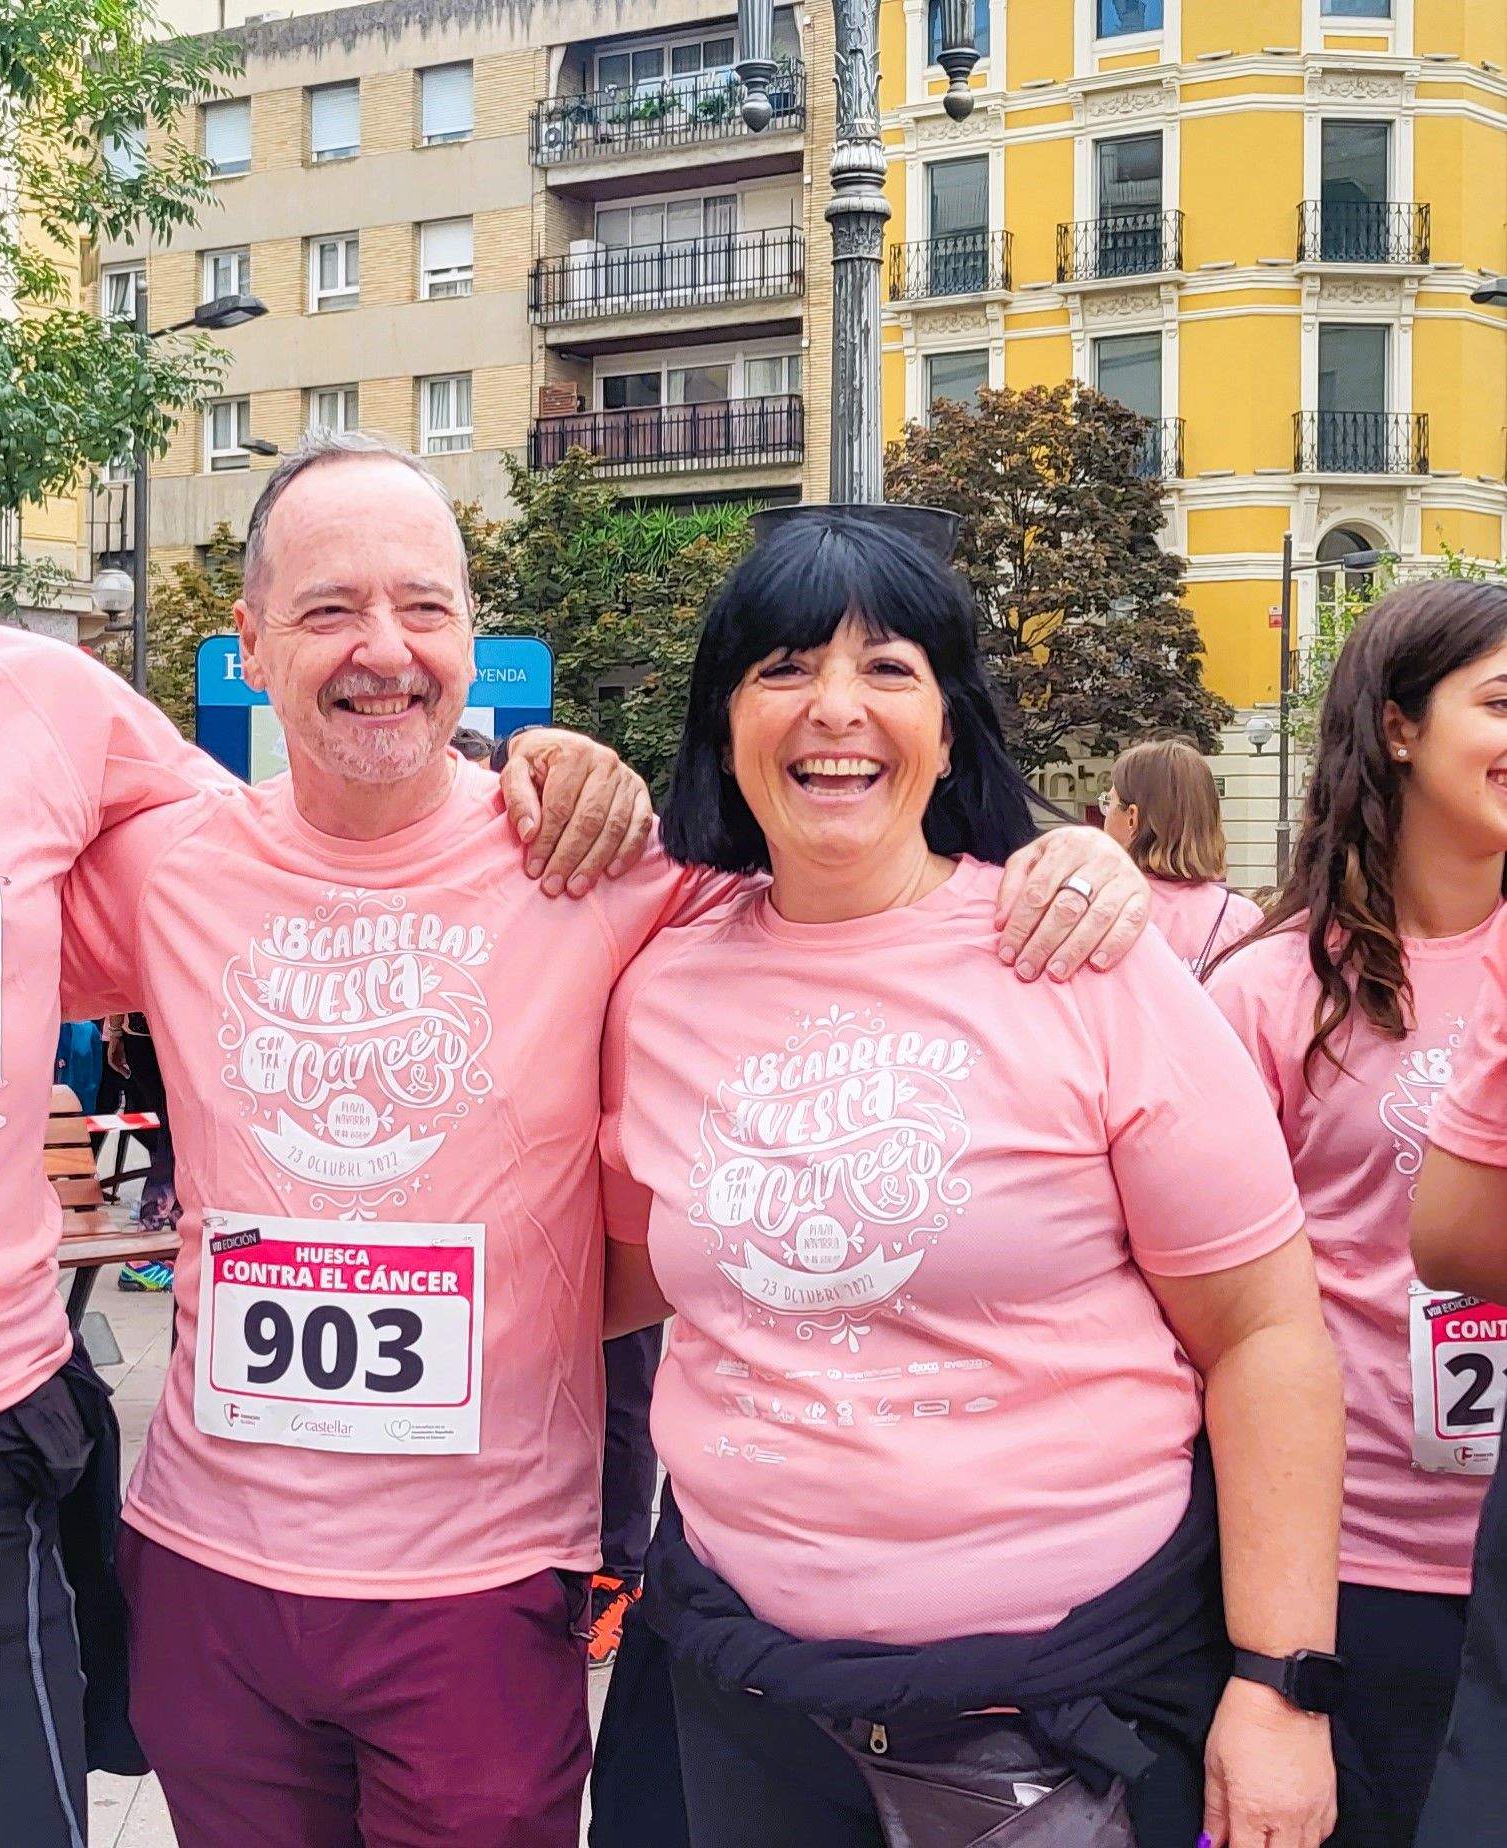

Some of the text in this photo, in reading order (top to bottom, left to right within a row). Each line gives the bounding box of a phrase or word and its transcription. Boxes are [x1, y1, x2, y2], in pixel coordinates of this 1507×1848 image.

[475, 668, 527, 682] YENDA
[255, 1036, 284, 1051] CON
[286, 1146, 304, 1165] 23
[367, 1151, 399, 1175] 2022
[724, 1165, 753, 1182] CON
[222, 1232, 257, 1250] EDICIÓN
[295, 1246, 370, 1267] HUESCA
[222, 1259, 459, 1294] CONTRA EL CÁNCER
[761, 1278, 778, 1297] 23
[243, 1299, 425, 1393] 903
[1444, 1352, 1507, 1427] 2
[304, 1420, 354, 1436] castellar
